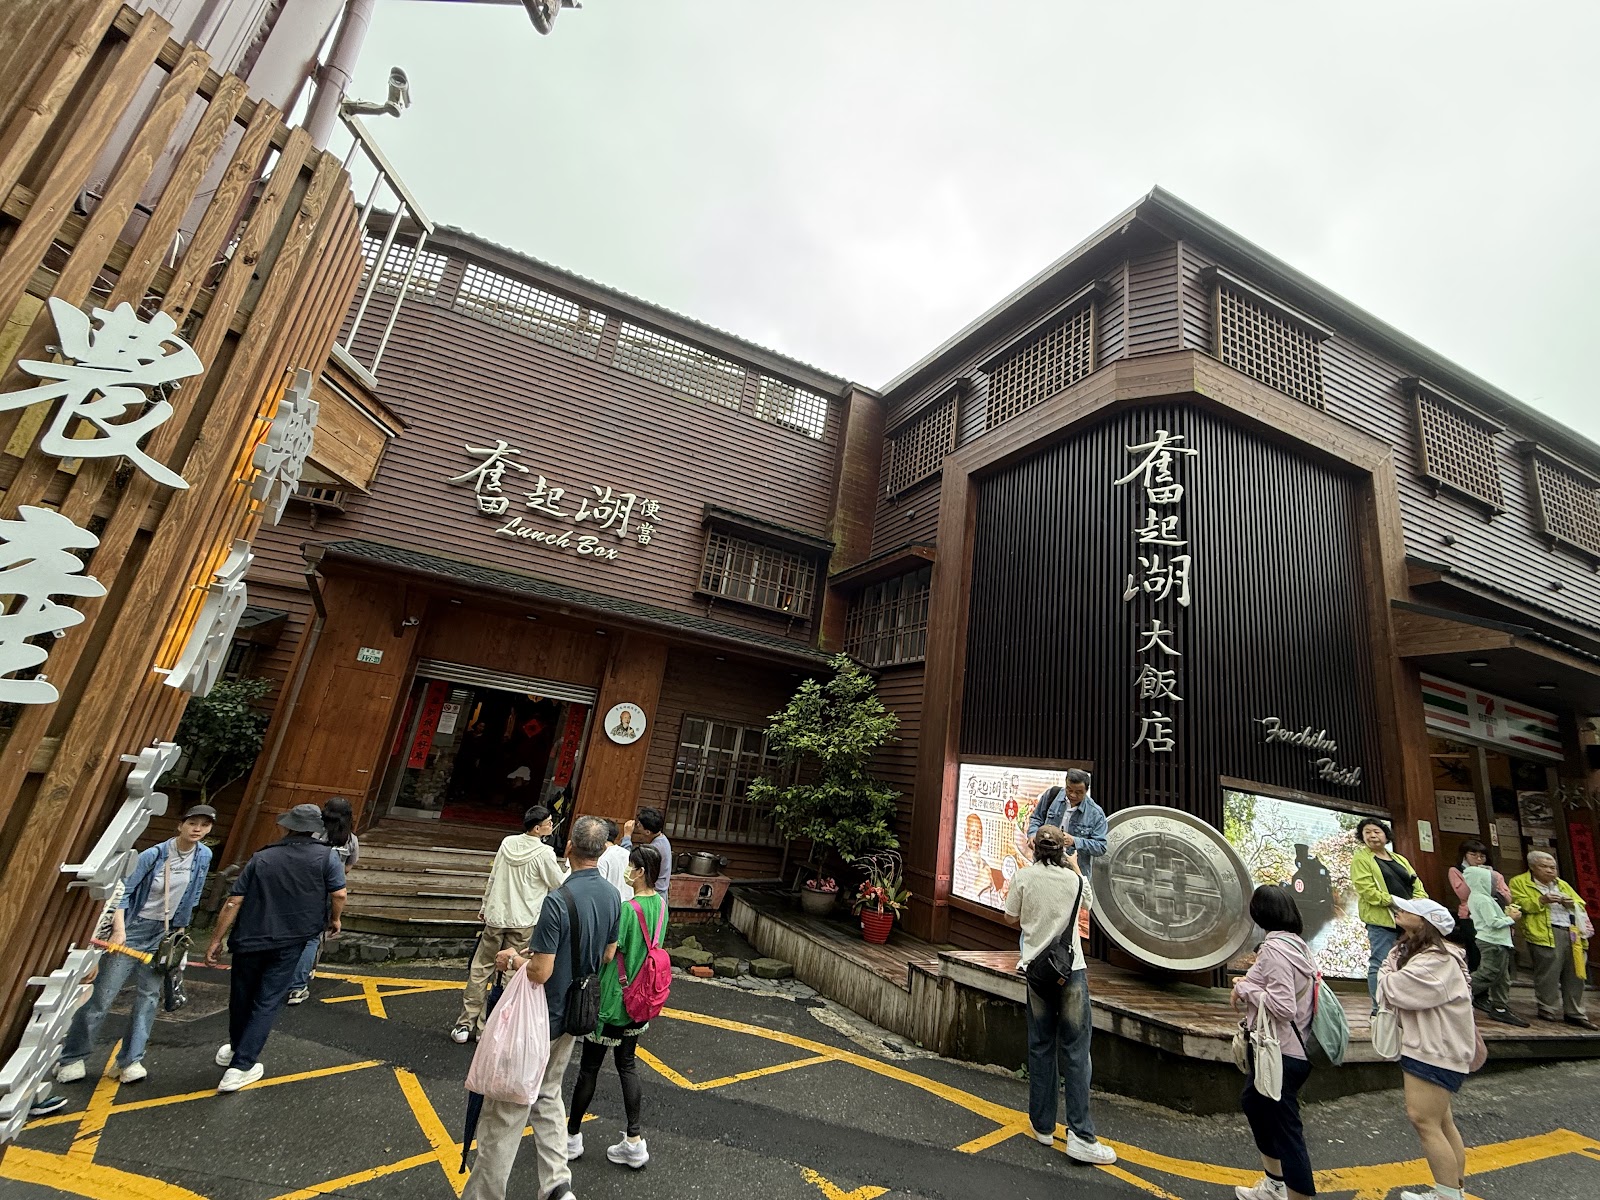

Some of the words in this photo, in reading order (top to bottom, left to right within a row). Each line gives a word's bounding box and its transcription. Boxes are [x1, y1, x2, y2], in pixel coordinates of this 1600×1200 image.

[449, 439, 637, 538] 奮起湖
[636, 498, 662, 546] 便當
[495, 516, 573, 549] Lunch
[576, 536, 618, 560] Box
[1114, 429, 1198, 754] 奮起湖大飯店
